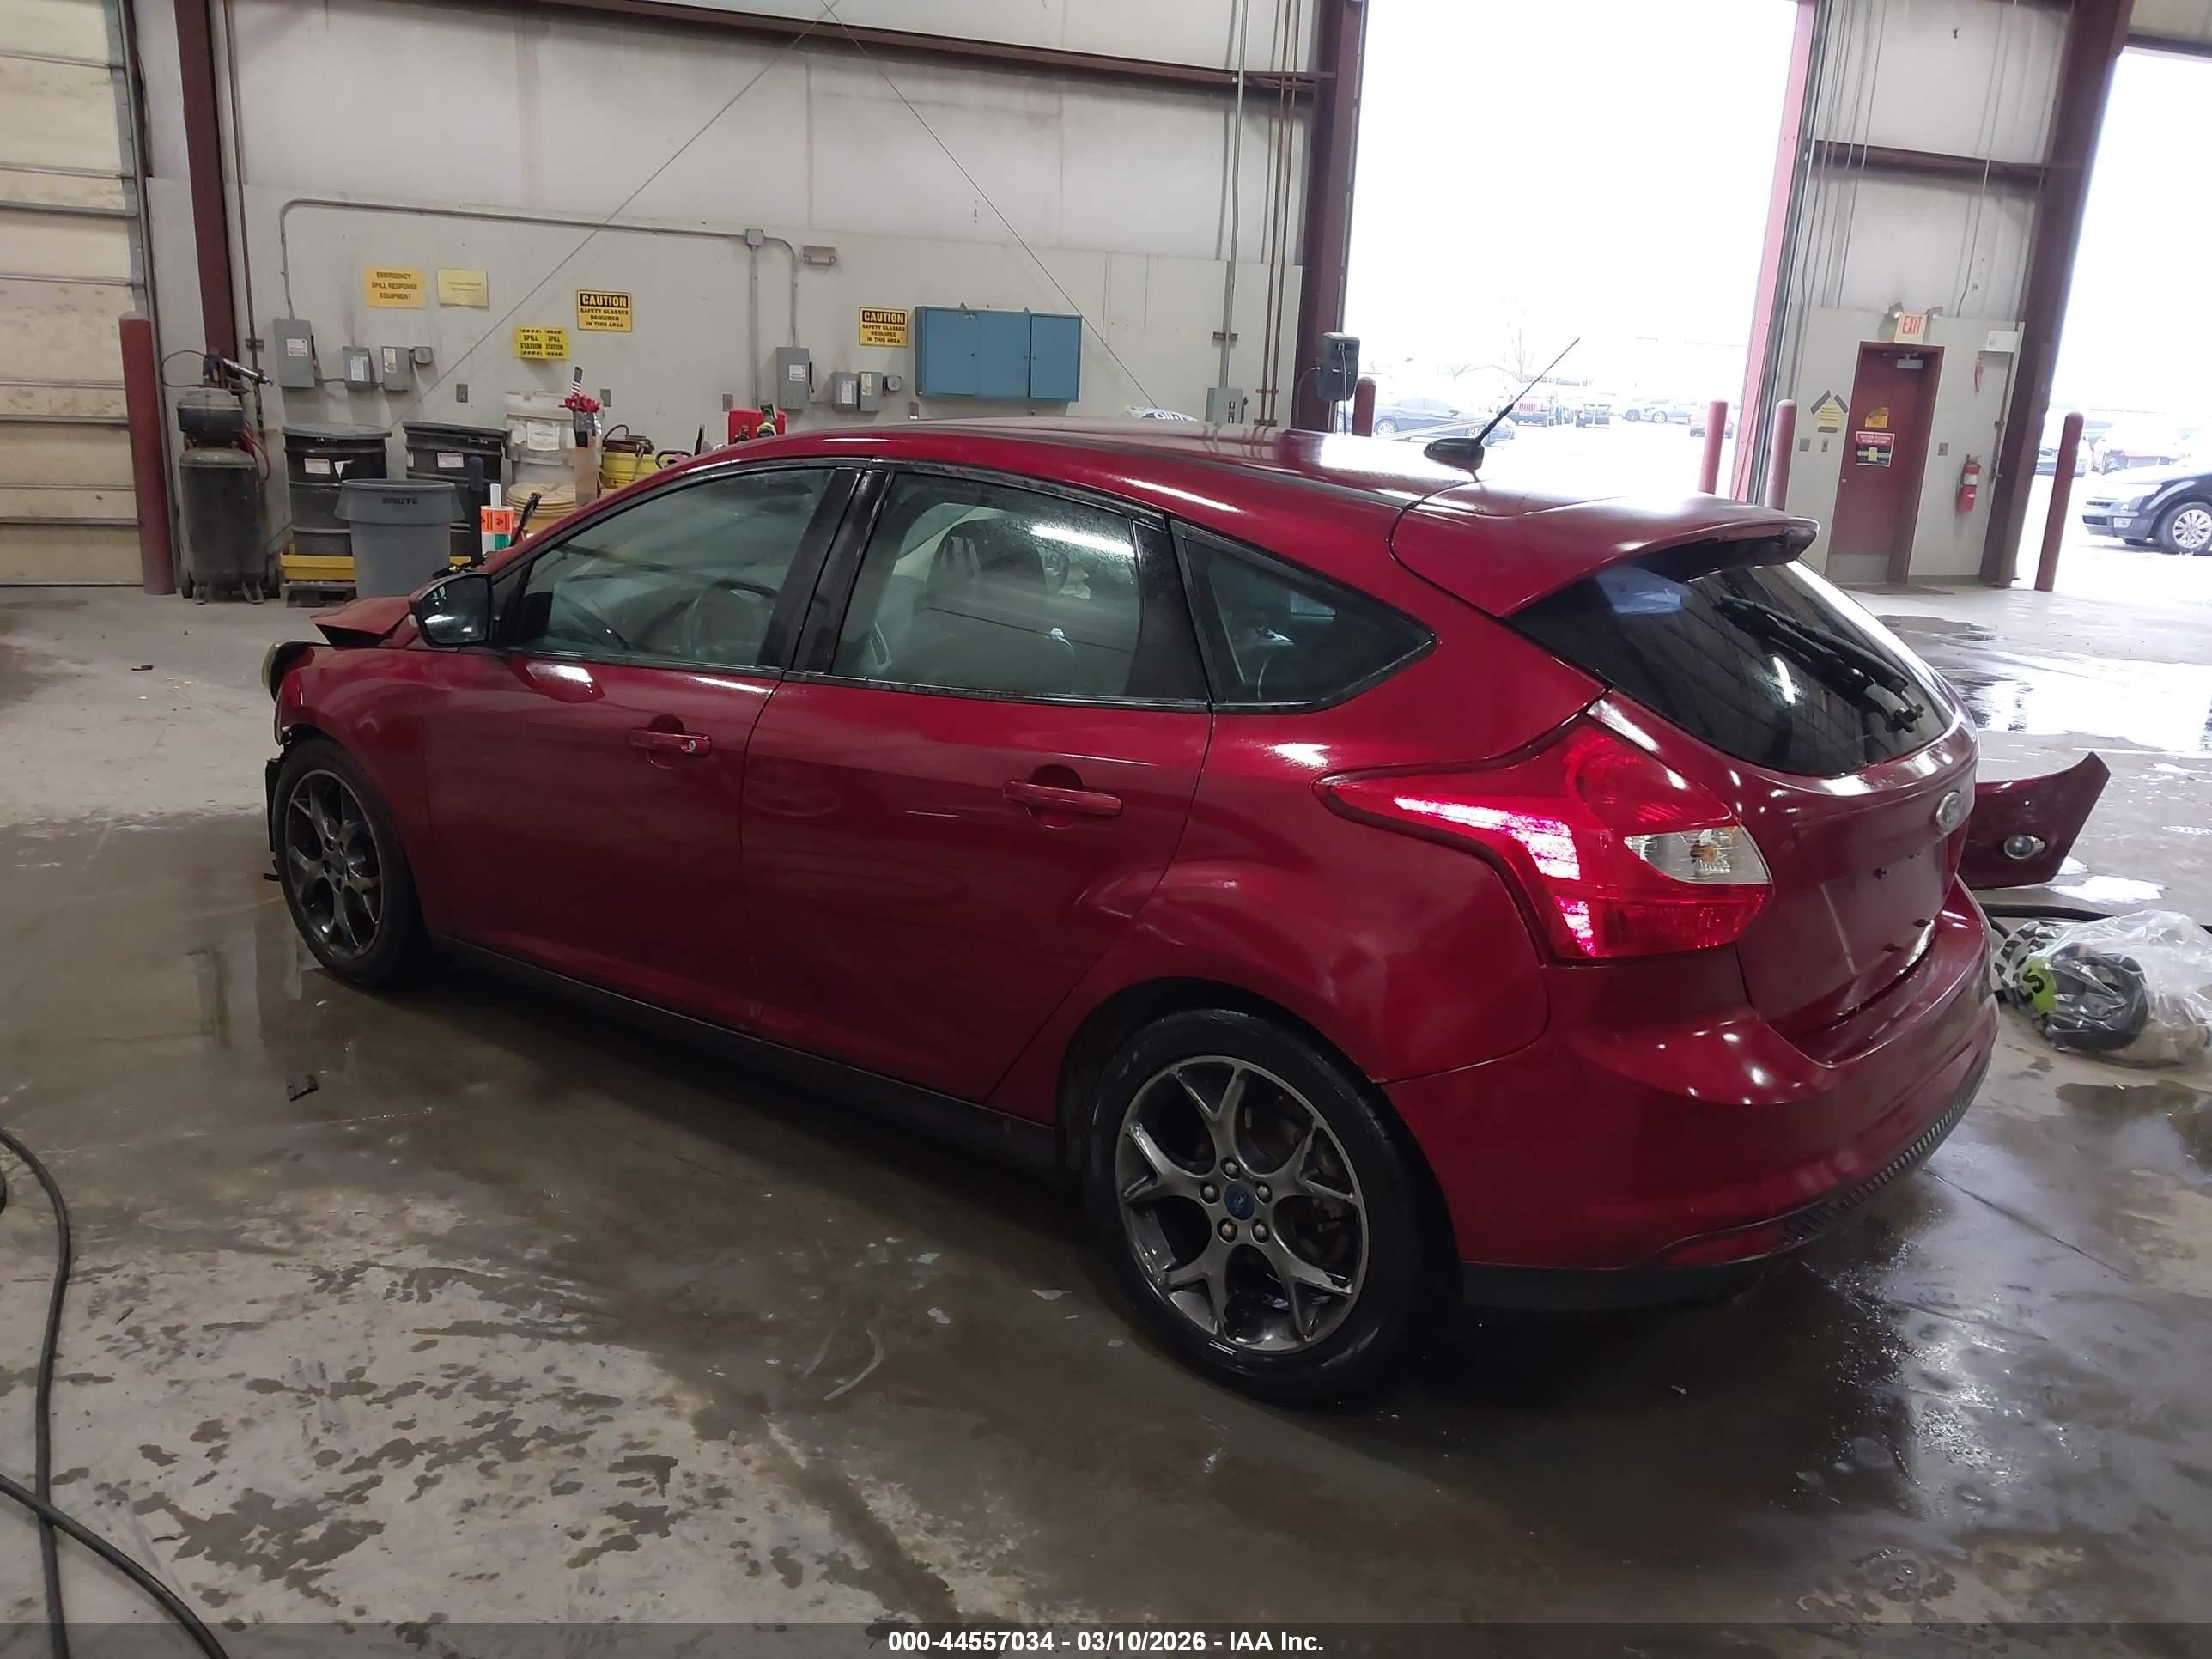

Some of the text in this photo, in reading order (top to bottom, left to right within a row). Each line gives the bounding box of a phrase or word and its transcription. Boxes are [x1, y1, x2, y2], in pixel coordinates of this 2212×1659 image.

[388, 282, 417, 290] RESPONSE
[582, 295, 627, 307] CAUTION
[864, 311, 904, 324] CAUTION
[1903, 315, 1923, 335] EXIT
